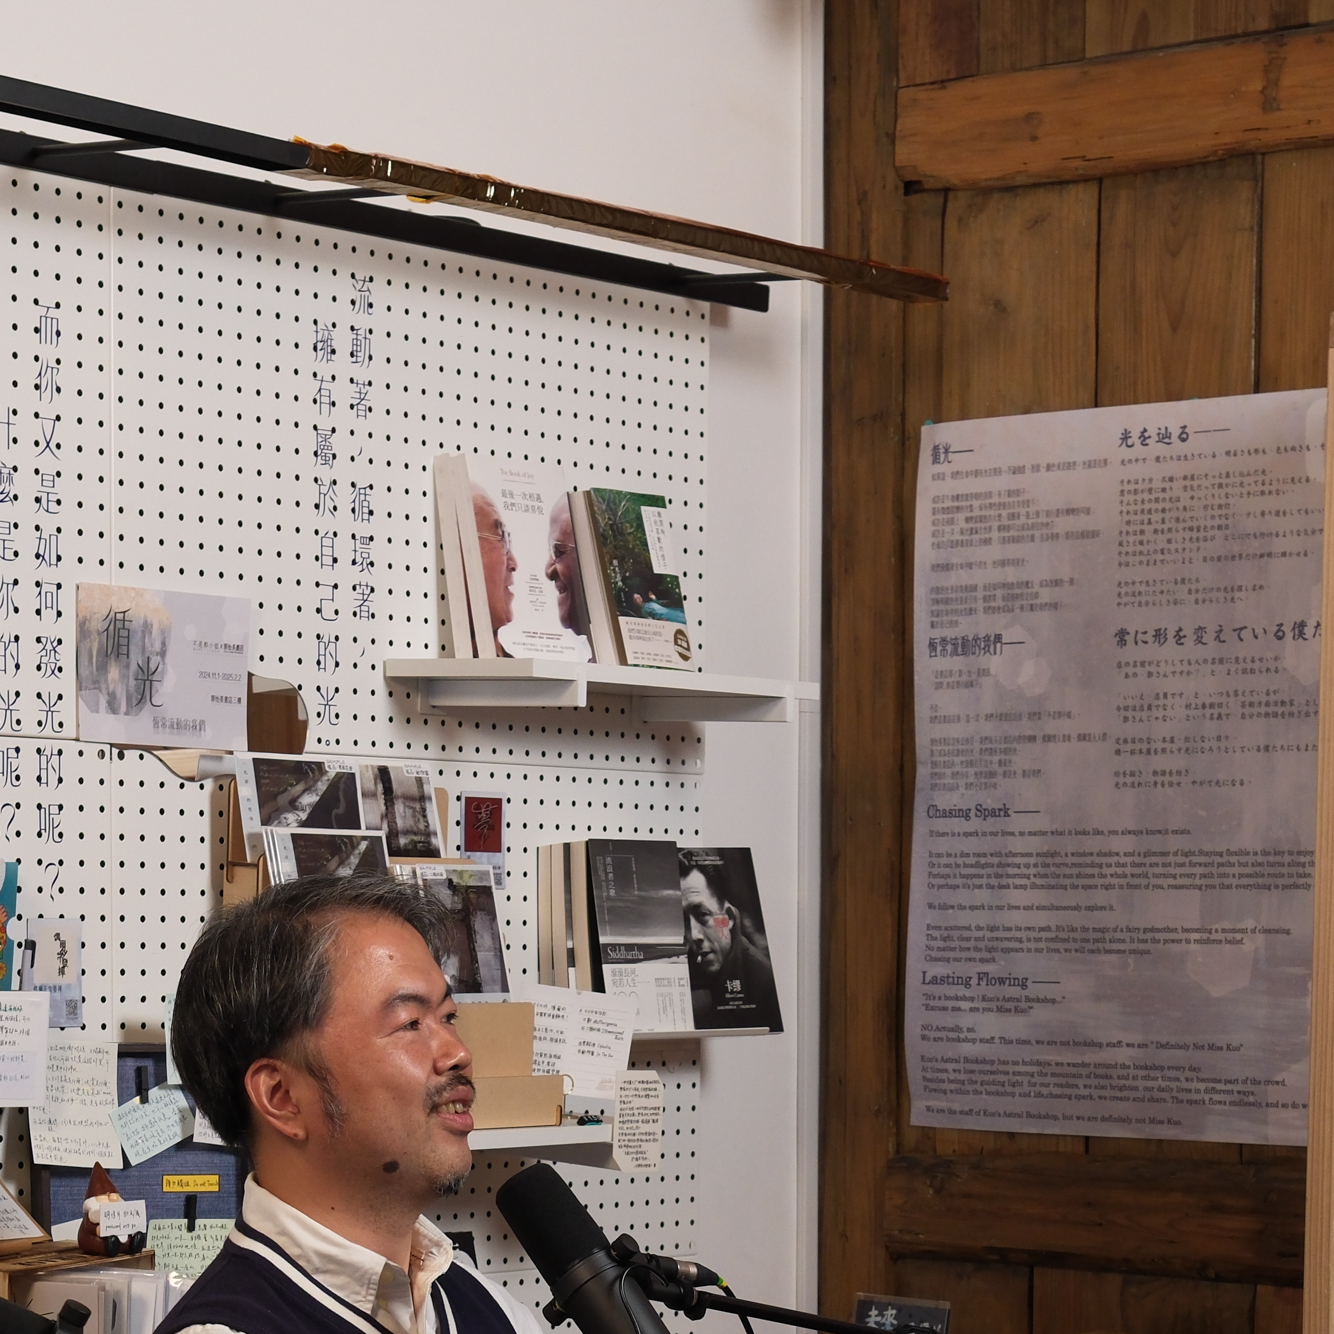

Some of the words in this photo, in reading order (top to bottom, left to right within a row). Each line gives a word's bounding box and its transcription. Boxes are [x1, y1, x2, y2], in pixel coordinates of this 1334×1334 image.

[927, 804, 972, 821] Chasing
[974, 803, 1011, 820] Spark
[607, 946, 644, 959] Siddhartha
[921, 971, 973, 989] Lasting
[975, 971, 1029, 990] Flowing
